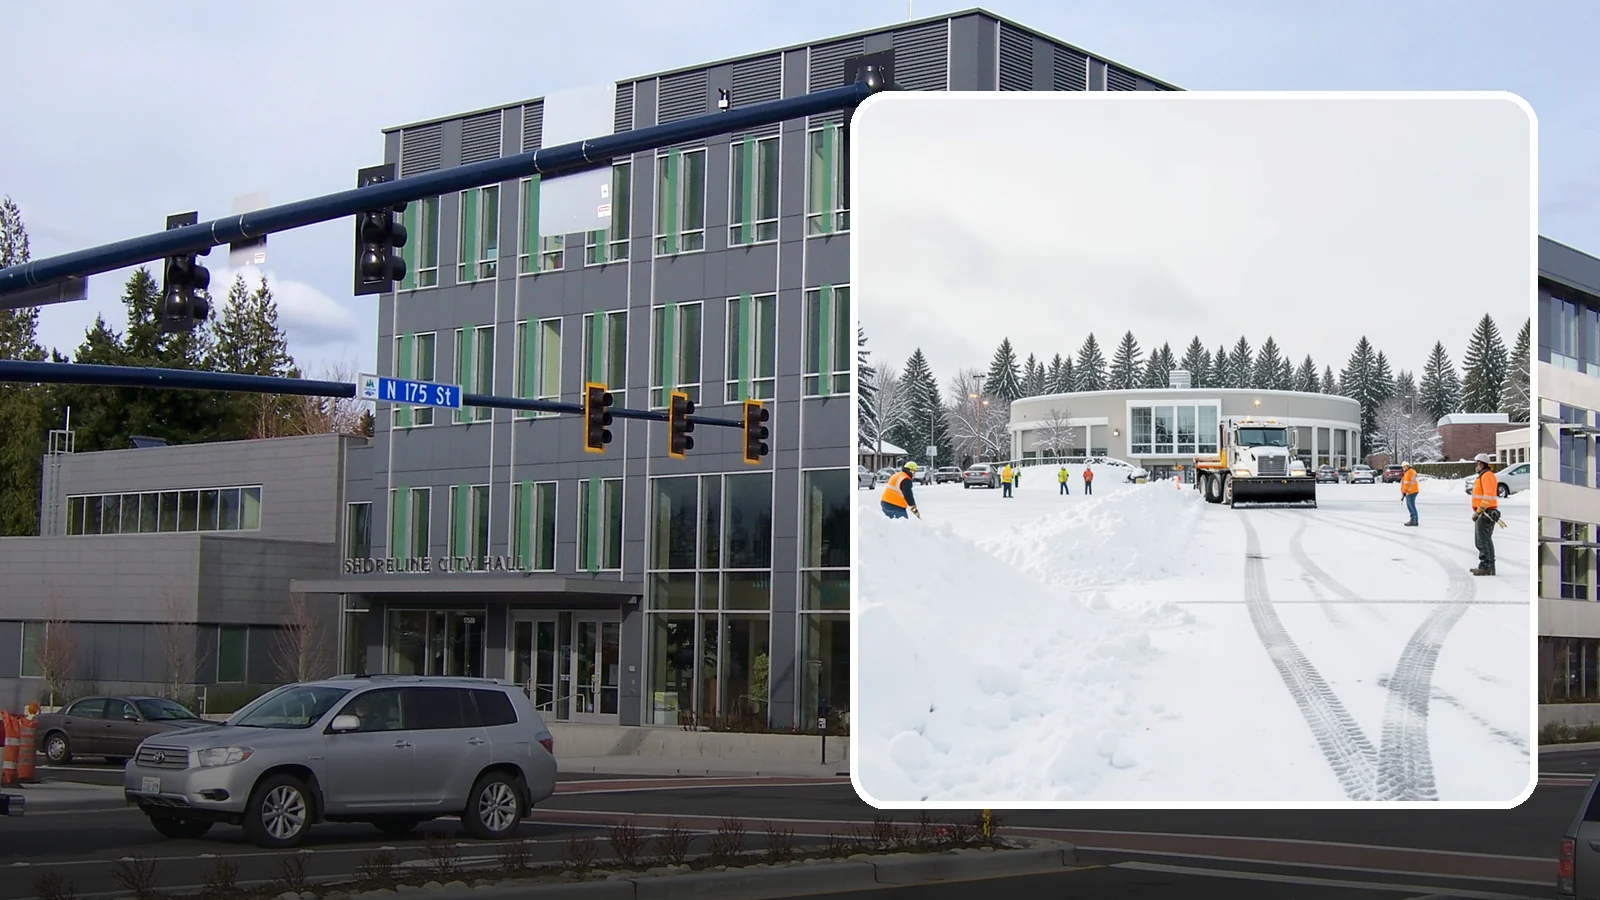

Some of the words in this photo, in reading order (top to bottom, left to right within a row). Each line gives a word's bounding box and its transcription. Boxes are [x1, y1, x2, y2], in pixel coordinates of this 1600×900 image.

[387, 380, 396, 400] N
[405, 382, 428, 403] 175
[436, 386, 451, 406] St
[344, 557, 432, 574] SHORELINE
[438, 555, 475, 573] CITY
[484, 555, 526, 573] HALL
